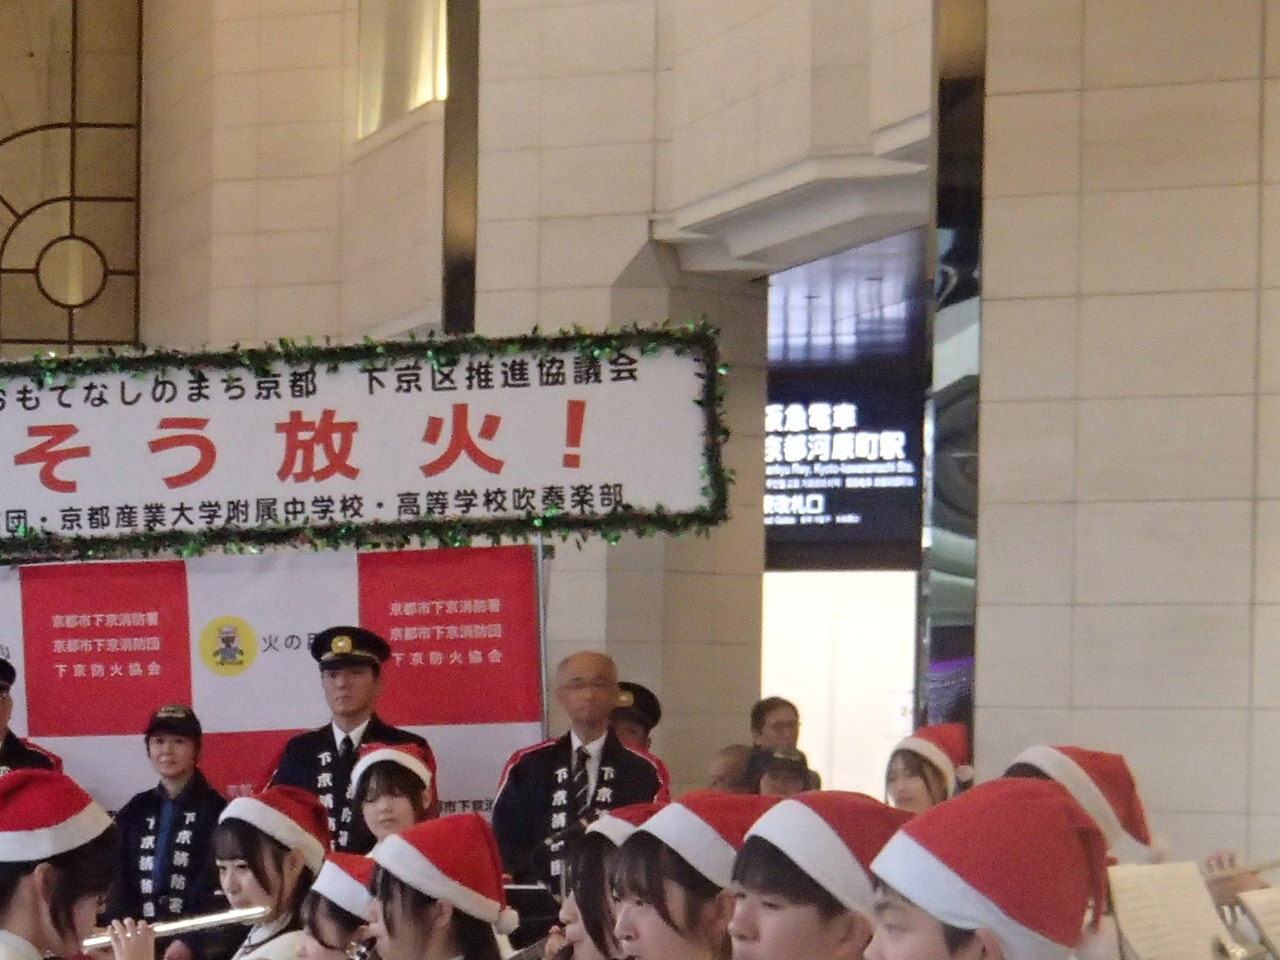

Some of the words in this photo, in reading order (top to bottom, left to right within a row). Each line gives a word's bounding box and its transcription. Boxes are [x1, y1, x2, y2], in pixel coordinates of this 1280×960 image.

[361, 353, 640, 396] 下京区推進協議会
